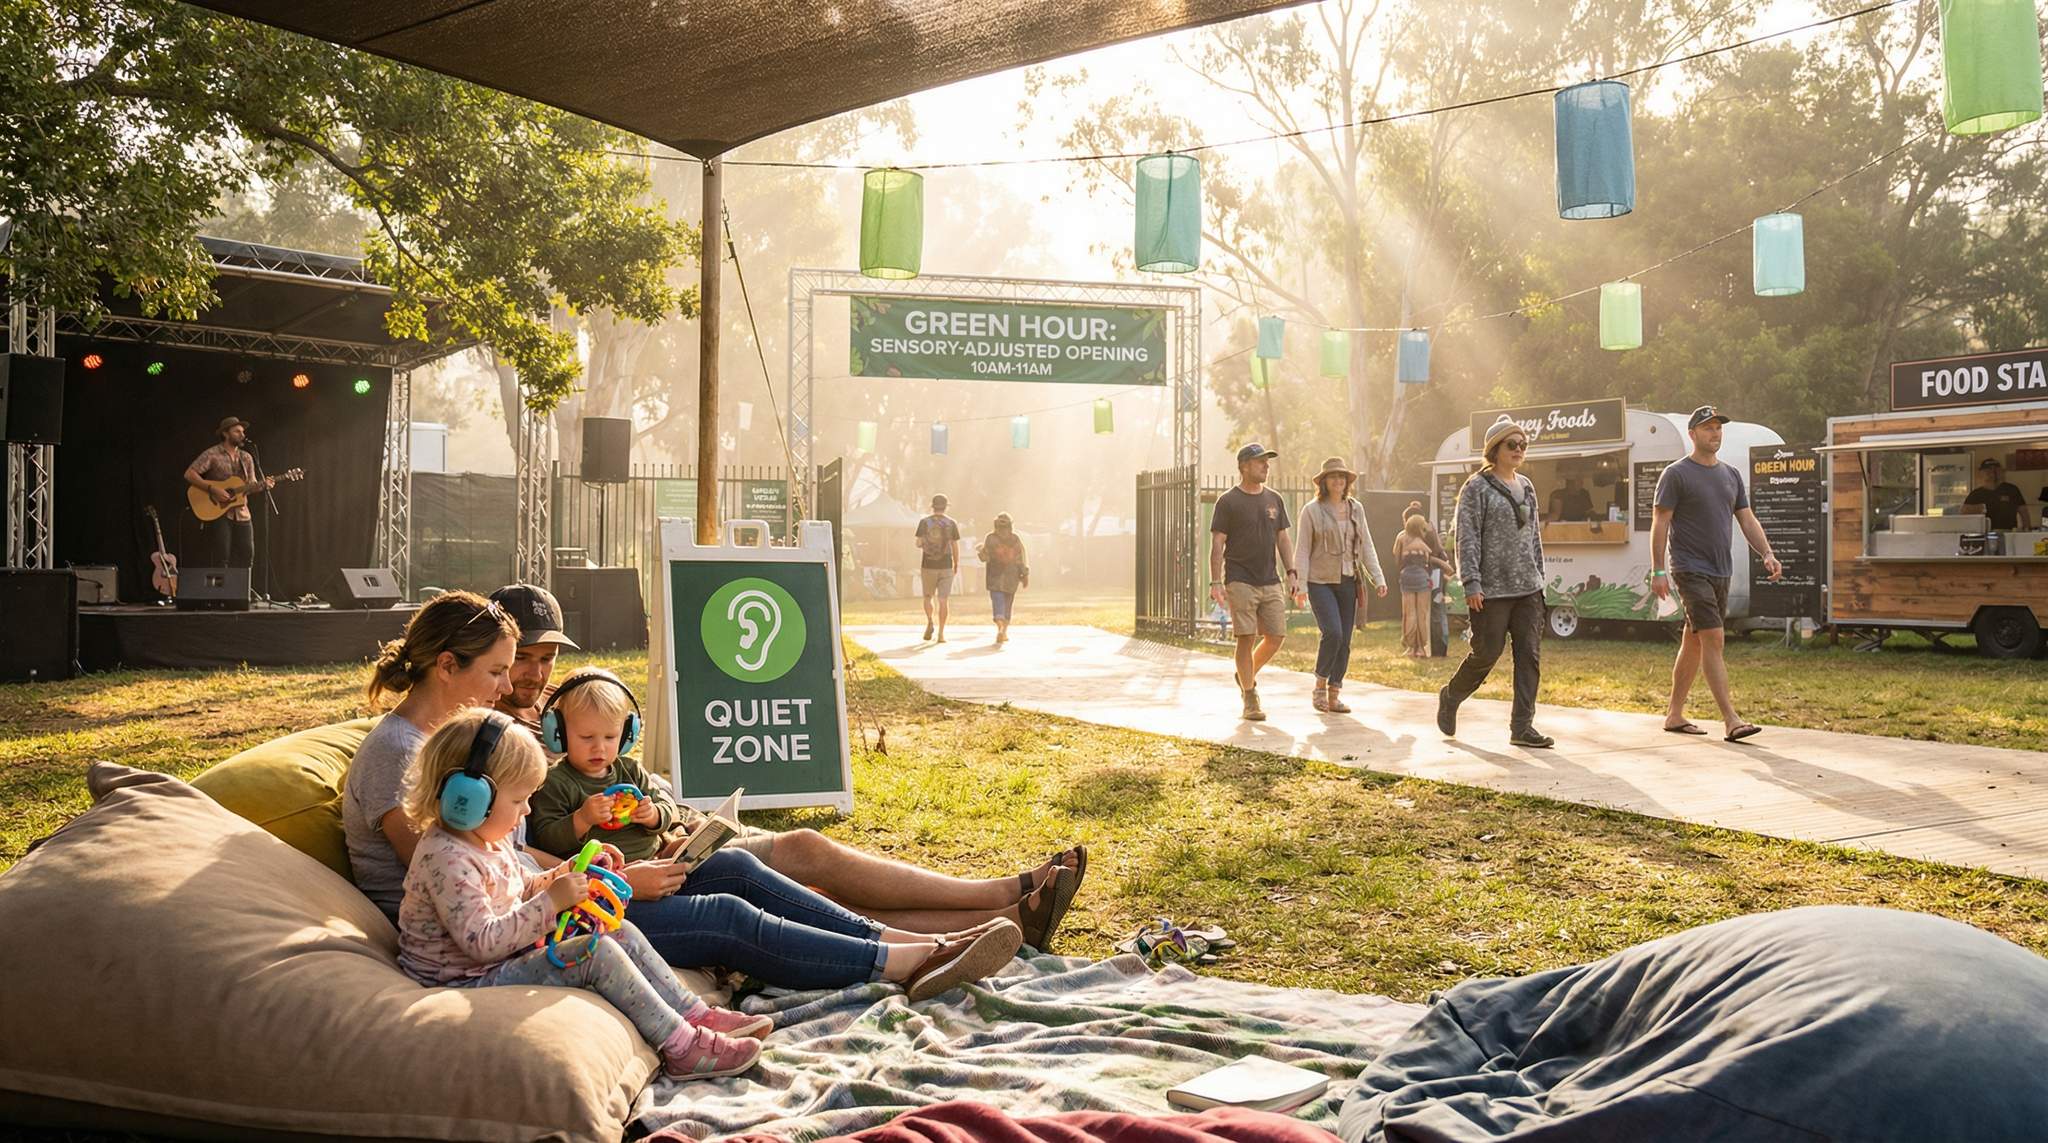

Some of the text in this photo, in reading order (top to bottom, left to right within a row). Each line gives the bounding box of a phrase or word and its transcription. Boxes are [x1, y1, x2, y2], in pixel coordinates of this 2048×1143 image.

[905, 311, 1117, 341] GREEN HOUR:
[870, 338, 1149, 362] SENSORY-ADJUSTED OPENING
[971, 361, 1052, 376] 10AM-11AM
[1921, 360, 2047, 398] FOOD STA
[1546, 408, 1597, 431] Foods
[1754, 459, 1815, 474] GREEN HOUR
[704, 699, 812, 728] QUIET
[712, 734, 811, 764] ZONE
